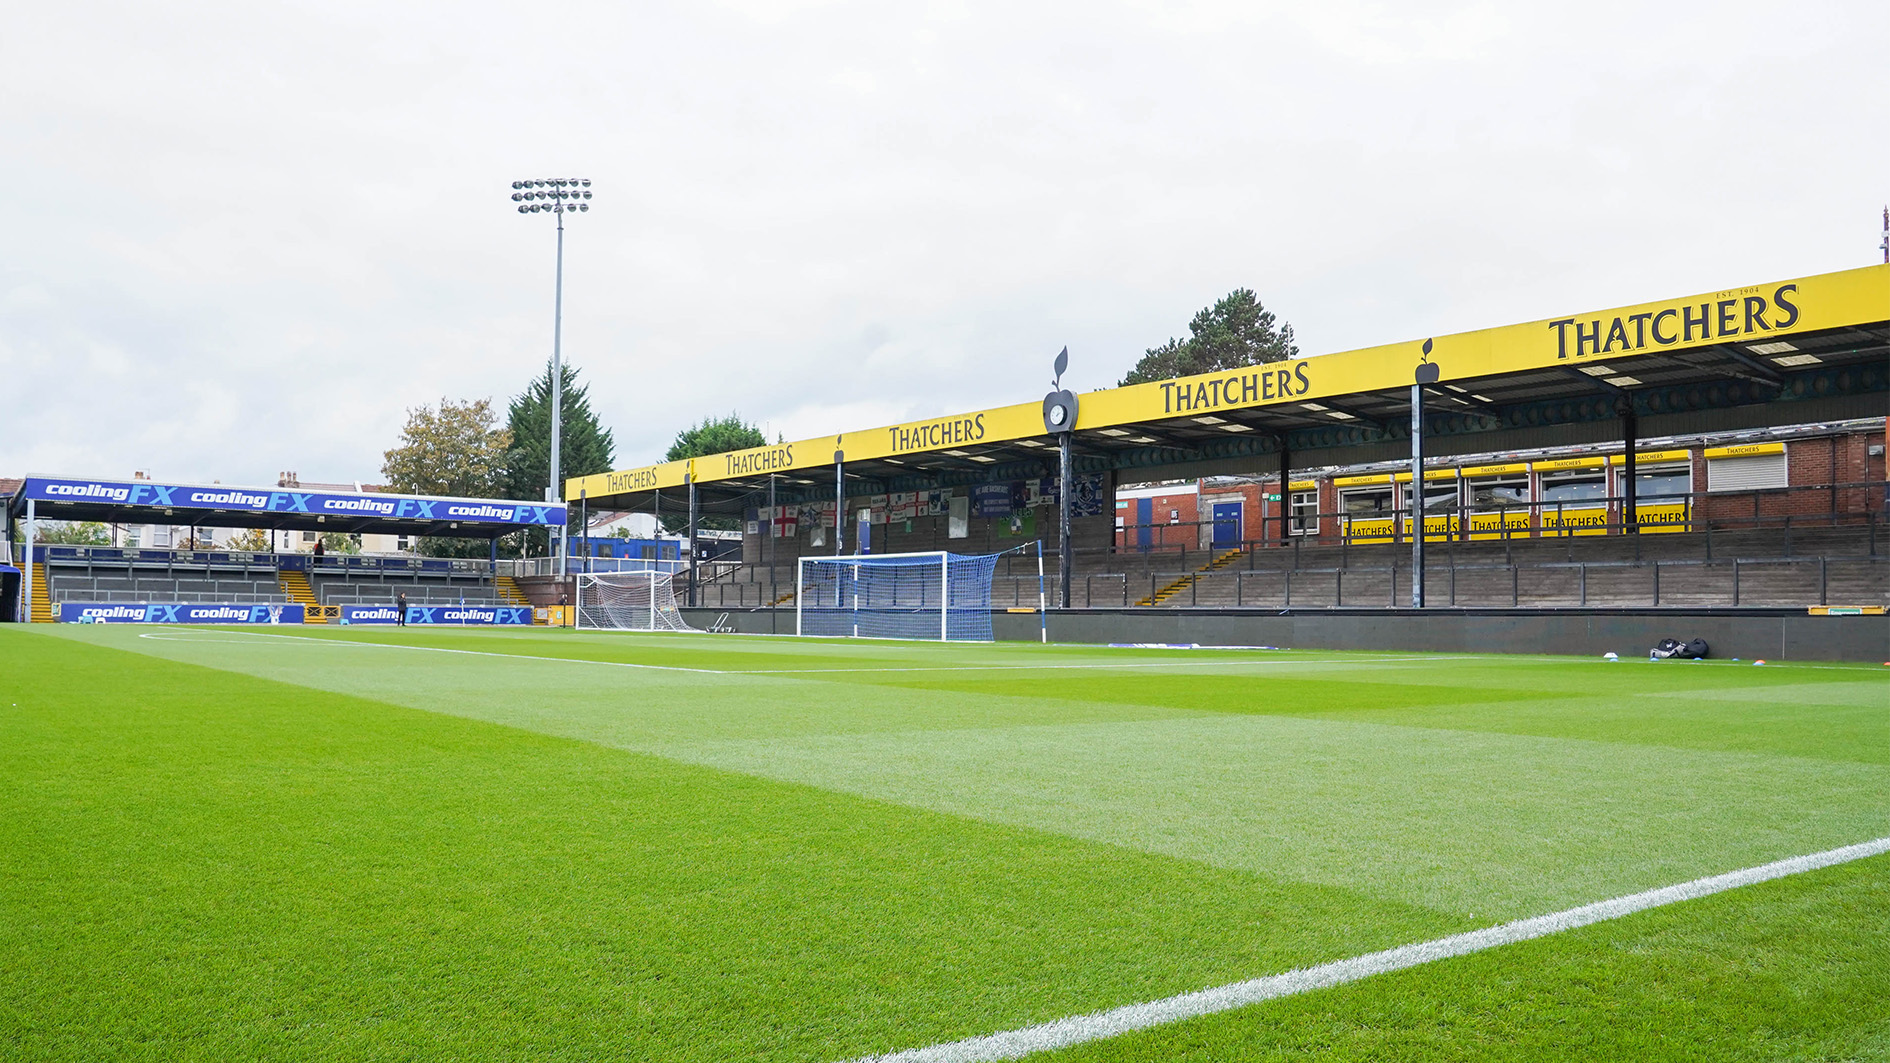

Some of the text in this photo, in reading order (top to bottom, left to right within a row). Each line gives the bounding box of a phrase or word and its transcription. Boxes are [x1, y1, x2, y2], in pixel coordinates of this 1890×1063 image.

[1740, 286, 1759, 296] 1904
[1548, 284, 1801, 360] THATCHERS
[1160, 361, 1311, 414] THATCHERS
[889, 413, 985, 451] THATCHERS
[726, 444, 793, 475] THATCHERS
[1635, 453, 1663, 461] HATCHERS
[1727, 446, 1760, 455] THATCHERS
[607, 467, 657, 492] THATCHERS
[1406, 522, 1458, 534] TTCHES
